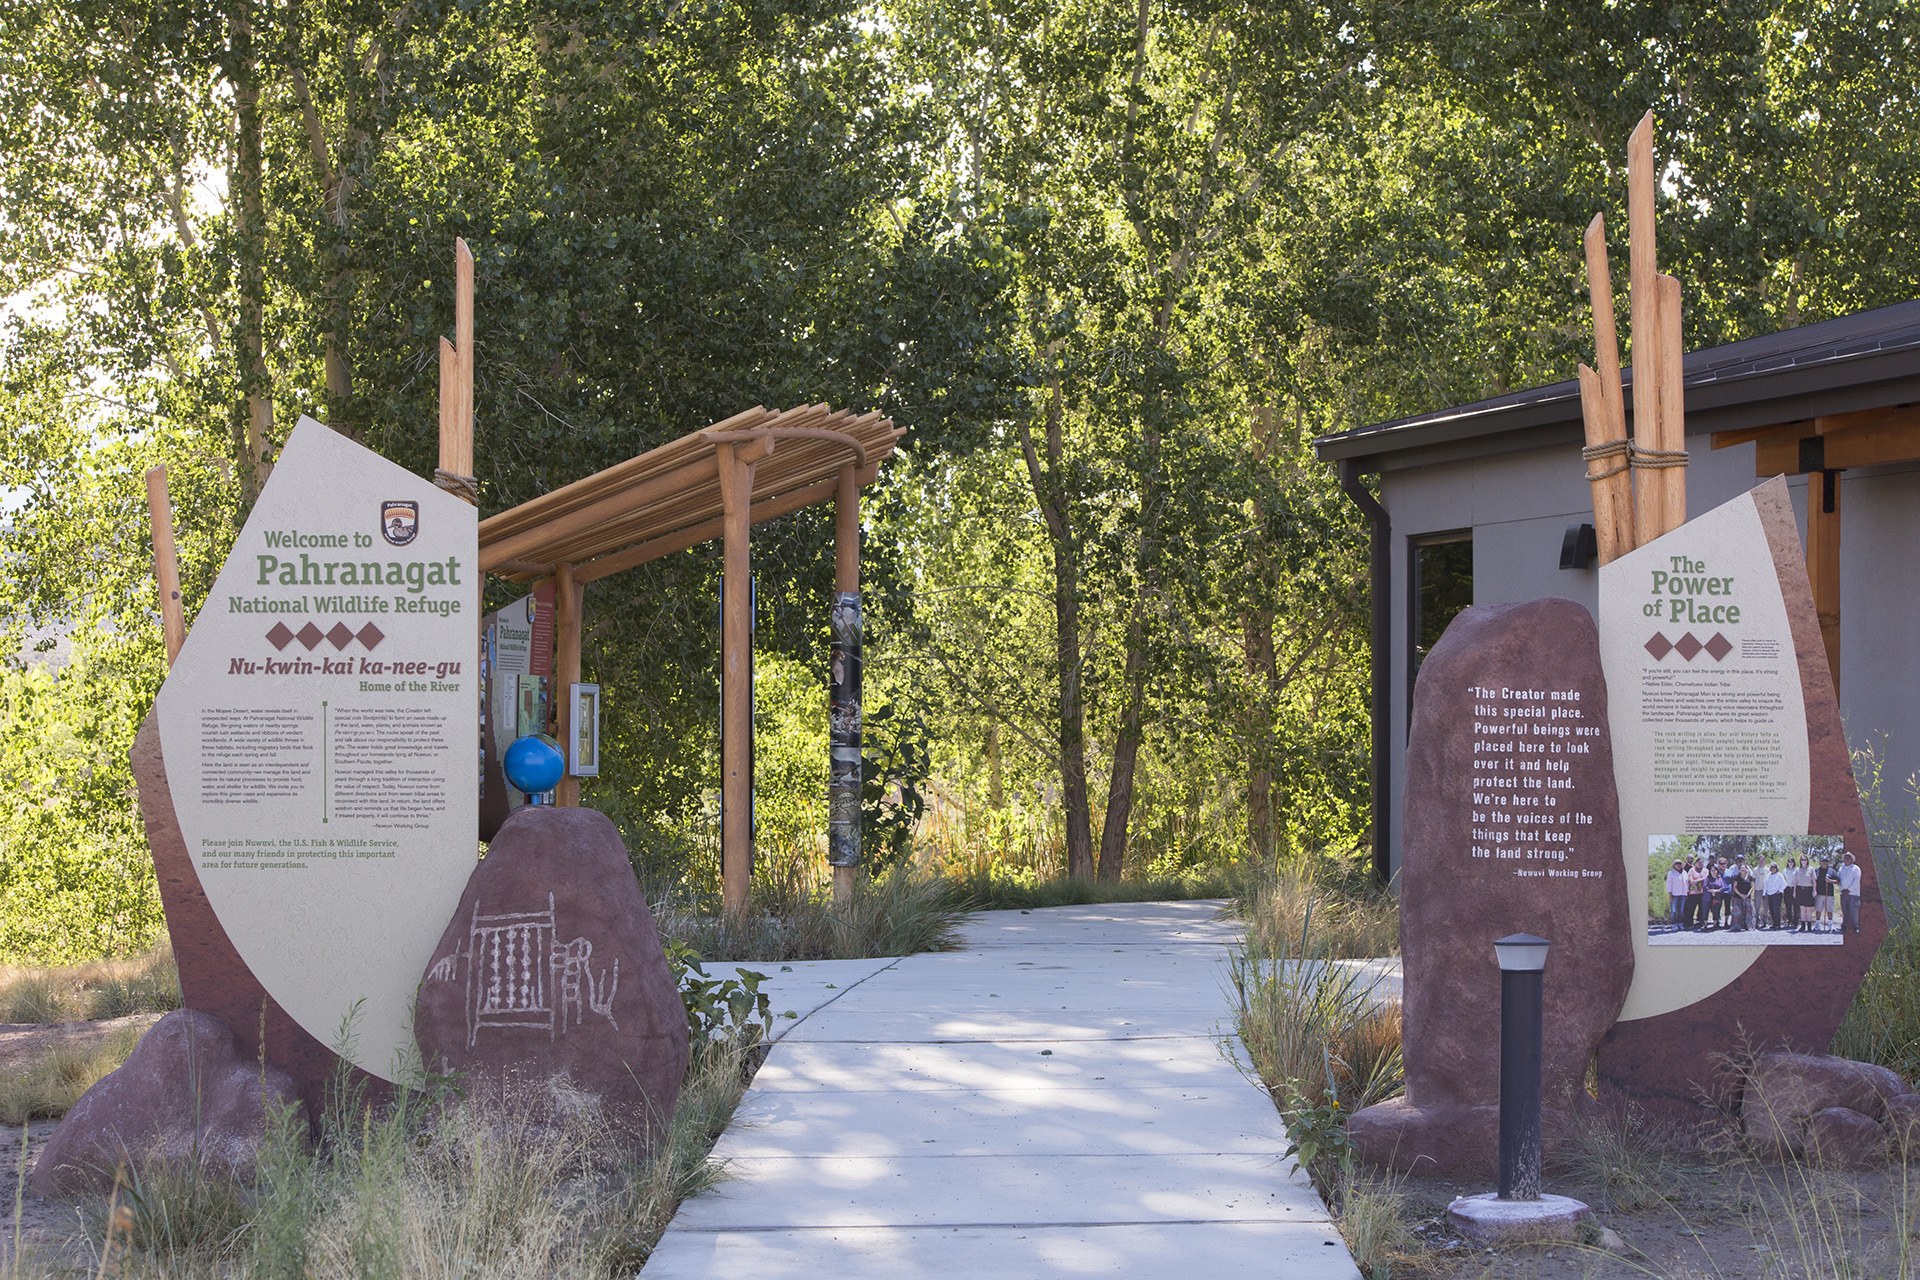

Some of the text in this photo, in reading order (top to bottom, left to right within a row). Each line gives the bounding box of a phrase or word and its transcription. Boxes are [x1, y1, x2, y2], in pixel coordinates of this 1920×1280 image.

[263, 530, 348, 547] Welcome
[353, 531, 372, 547] to
[1670, 555, 1705, 573] The
[256, 553, 461, 593] Pahranagat
[1651, 570, 1734, 595] Power
[228, 595, 460, 617] National Wildlife Refuge
[1642, 598, 1740, 623] of Place
[499, 625, 530, 644] Pahranagat
[227, 656, 460, 679] Nu-kwin-kai ka-nee-gu
[359, 680, 459, 691] Home of the River
[1468, 686, 1579, 700] “The Creator made
[1474, 704, 1583, 720] this special place.
[1474, 722, 1599, 737] Powerful beings were
[1474, 739, 1589, 753] placed here to look
[1473, 758, 1568, 772] over it and help
[1473, 776, 1574, 789] protect the land.
[1473, 792, 1555, 806] We’re here to
[1472, 810, 1592, 824] be the voices of the
[202, 838, 226, 846] Please
[227, 838, 243, 848] join
[245, 839, 276, 847] Nuwuvi,
[278, 838, 291, 846] the
[336, 838, 367, 846] Wildlife
[368, 839, 399, 847] Service,
[1472, 828, 1570, 843] things that keep
[201, 849, 216, 857] and
[233, 851, 255, 859] many
[256, 849, 284, 857] friends
[286, 849, 294, 857] in
[297, 850, 336, 859] protecting
[338, 849, 353, 857] this
[355, 850, 395, 859] important
[1472, 846, 1574, 861] the land strong.”
[220, 860, 231, 868] for
[233, 860, 258, 868] future
[259, 860, 307, 870] generations.
[1548, 868, 1578, 878] Working
[1582, 869, 1602, 878] Group
